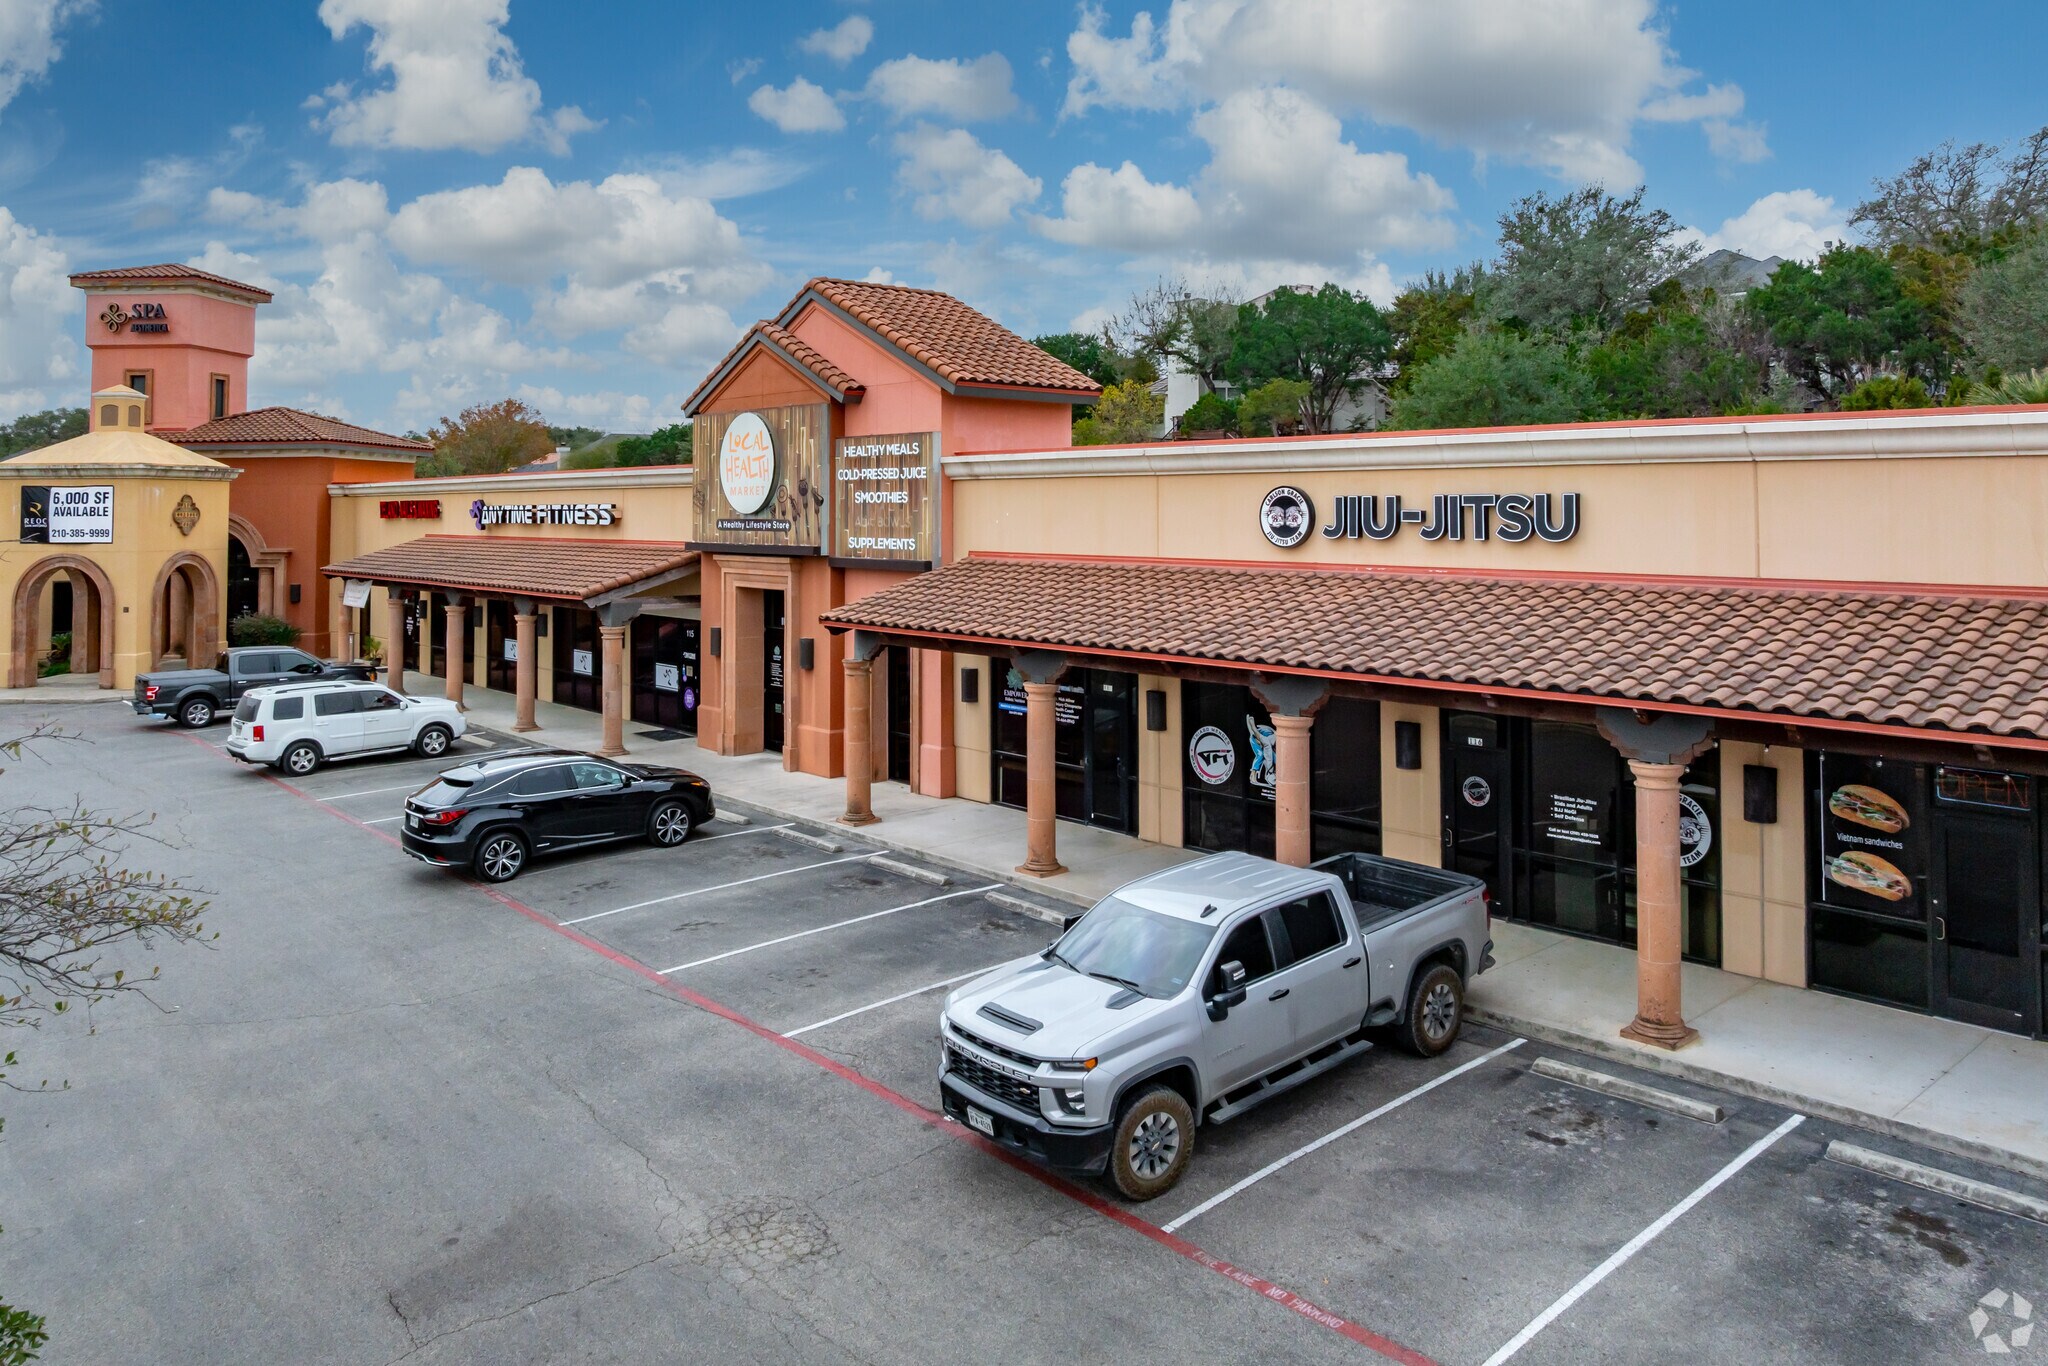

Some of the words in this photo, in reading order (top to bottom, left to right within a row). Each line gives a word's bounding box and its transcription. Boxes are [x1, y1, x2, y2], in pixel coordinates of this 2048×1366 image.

[131, 303, 168, 319] SPA
[728, 430, 769, 453] LOCAL
[844, 444, 885, 457] HEALTHY
[886, 443, 920, 455] MEALS
[725, 454, 770, 482] HEALTH
[838, 467, 899, 480] COLD-PRESSED
[901, 466, 927, 479] JUICE
[53, 491, 89, 506] 6,000
[94, 491, 110, 504] SF
[730, 485, 765, 497] MARKET
[855, 490, 908, 503] SMOOTHIES
[1265, 489, 1286, 506] CARLSON
[1287, 489, 1304, 505] GRACIE
[53, 506, 109, 517] AVAILABLE
[481, 504, 533, 524] ANYTIME
[536, 503, 615, 526] FITNESS
[1321, 492, 1580, 542] JIU-JITSU
[723, 520, 745, 529] Healthy
[746, 521, 771, 530] Lifestyle
[772, 521, 790, 529] Store
[52, 528, 110, 538] 210-385-9999
[1267, 530, 1289, 545] JIU-JITSU
[1290, 530, 1303, 543] TEAM
[848, 537, 916, 550] SUPPLEMENTS
[686, 629, 695, 638] 115
[1468, 737, 1483, 746] 116
[1941, 771, 2029, 808] OPEN
[1836, 832, 1864, 844] Vietnam
[1864, 837, 1904, 850] sandwiches
[1682, 849, 1703, 864] TEAM
[945, 1037, 1035, 1082] CHEVROLET
[1192, 1250, 1222, 1269] FIRE
[1223, 1267, 1261, 1287] LANE
[1265, 1286, 1289, 1300] NO
[1288, 1298, 1345, 1329] PARKING
